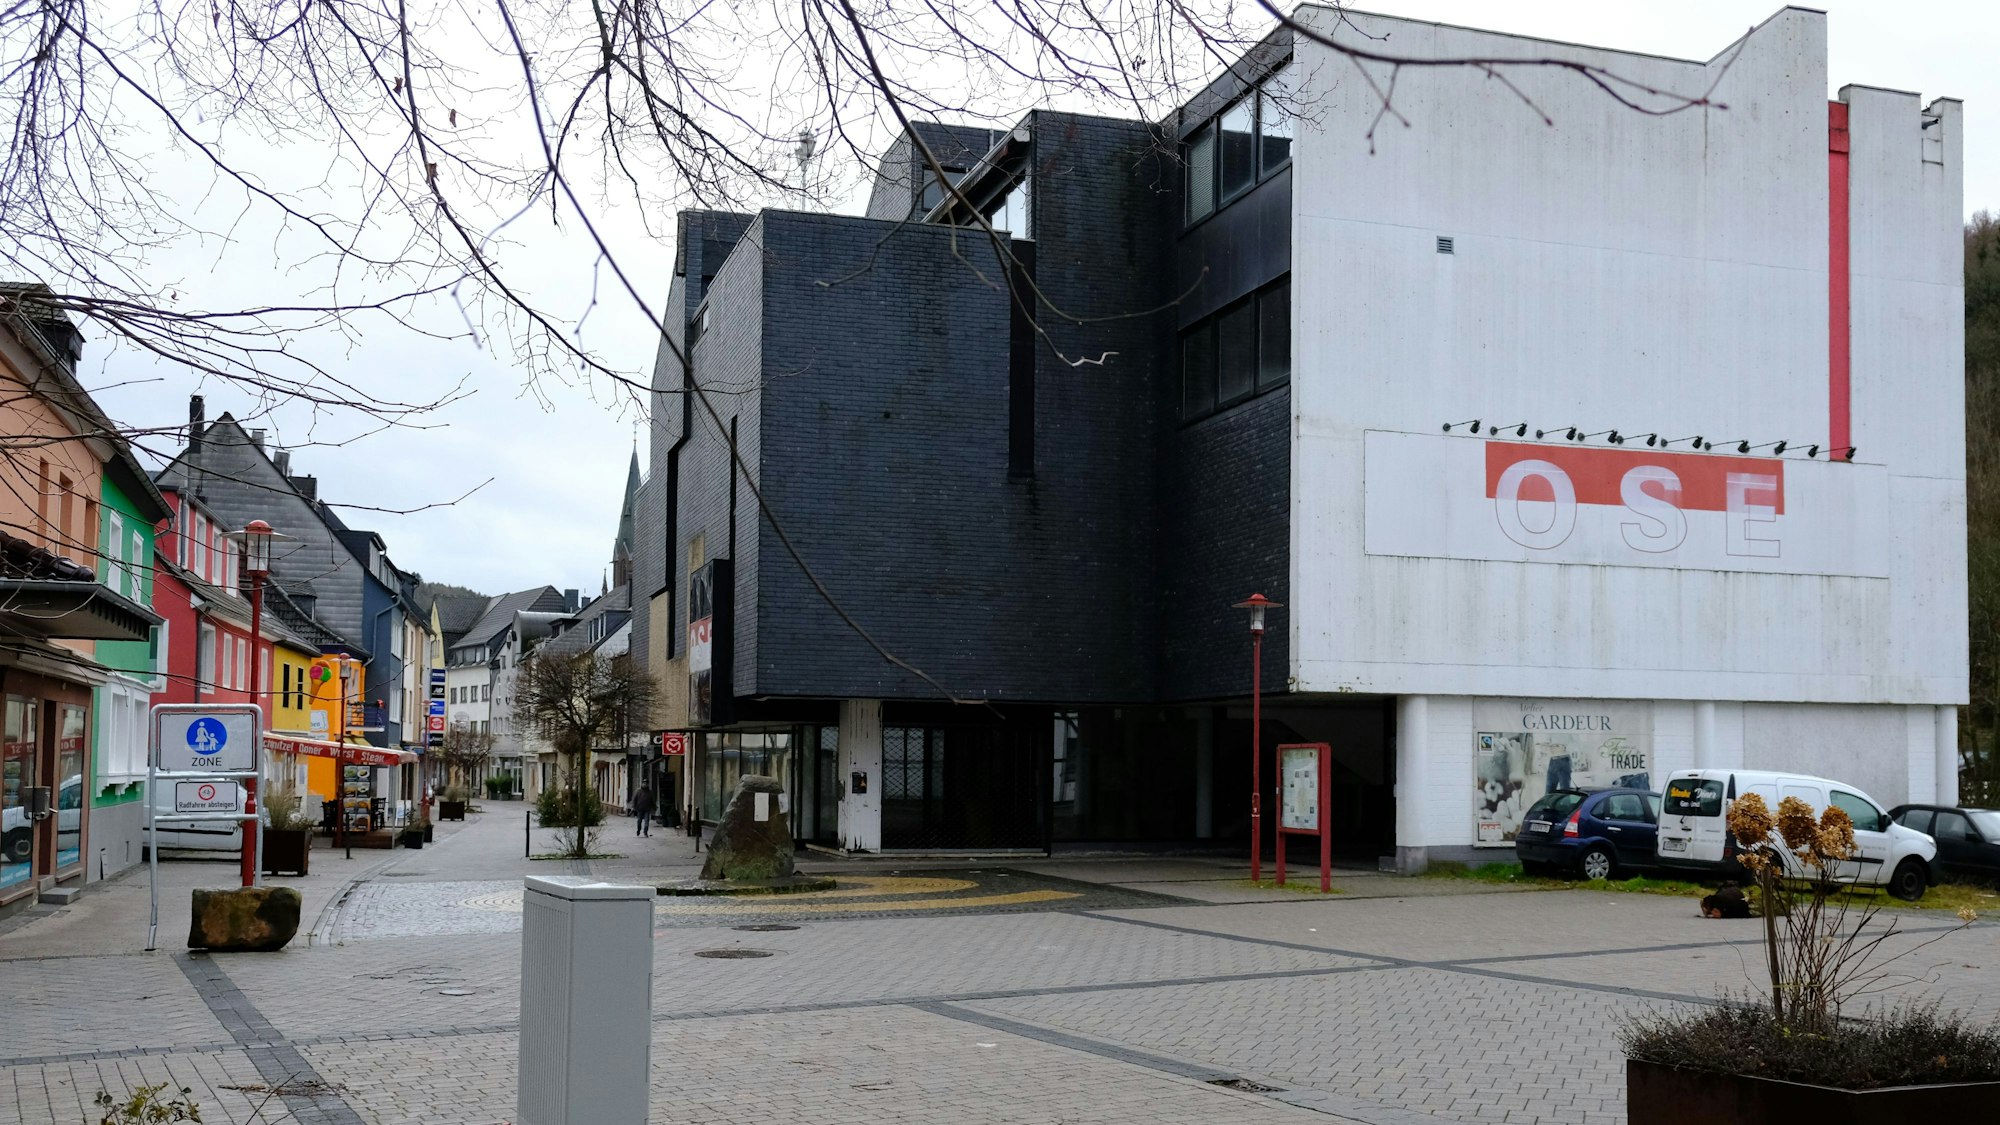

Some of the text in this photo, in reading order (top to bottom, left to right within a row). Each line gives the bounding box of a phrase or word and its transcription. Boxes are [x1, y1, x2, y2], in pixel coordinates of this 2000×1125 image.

[1495, 459, 1781, 557] OSE
[1522, 714, 1612, 731] GARDEUR
[263, 739, 294, 752] chnitzel
[191, 757, 222, 767] ZONE
[1609, 754, 1646, 769] TRADE
[208, 801, 235, 809] absteigen
